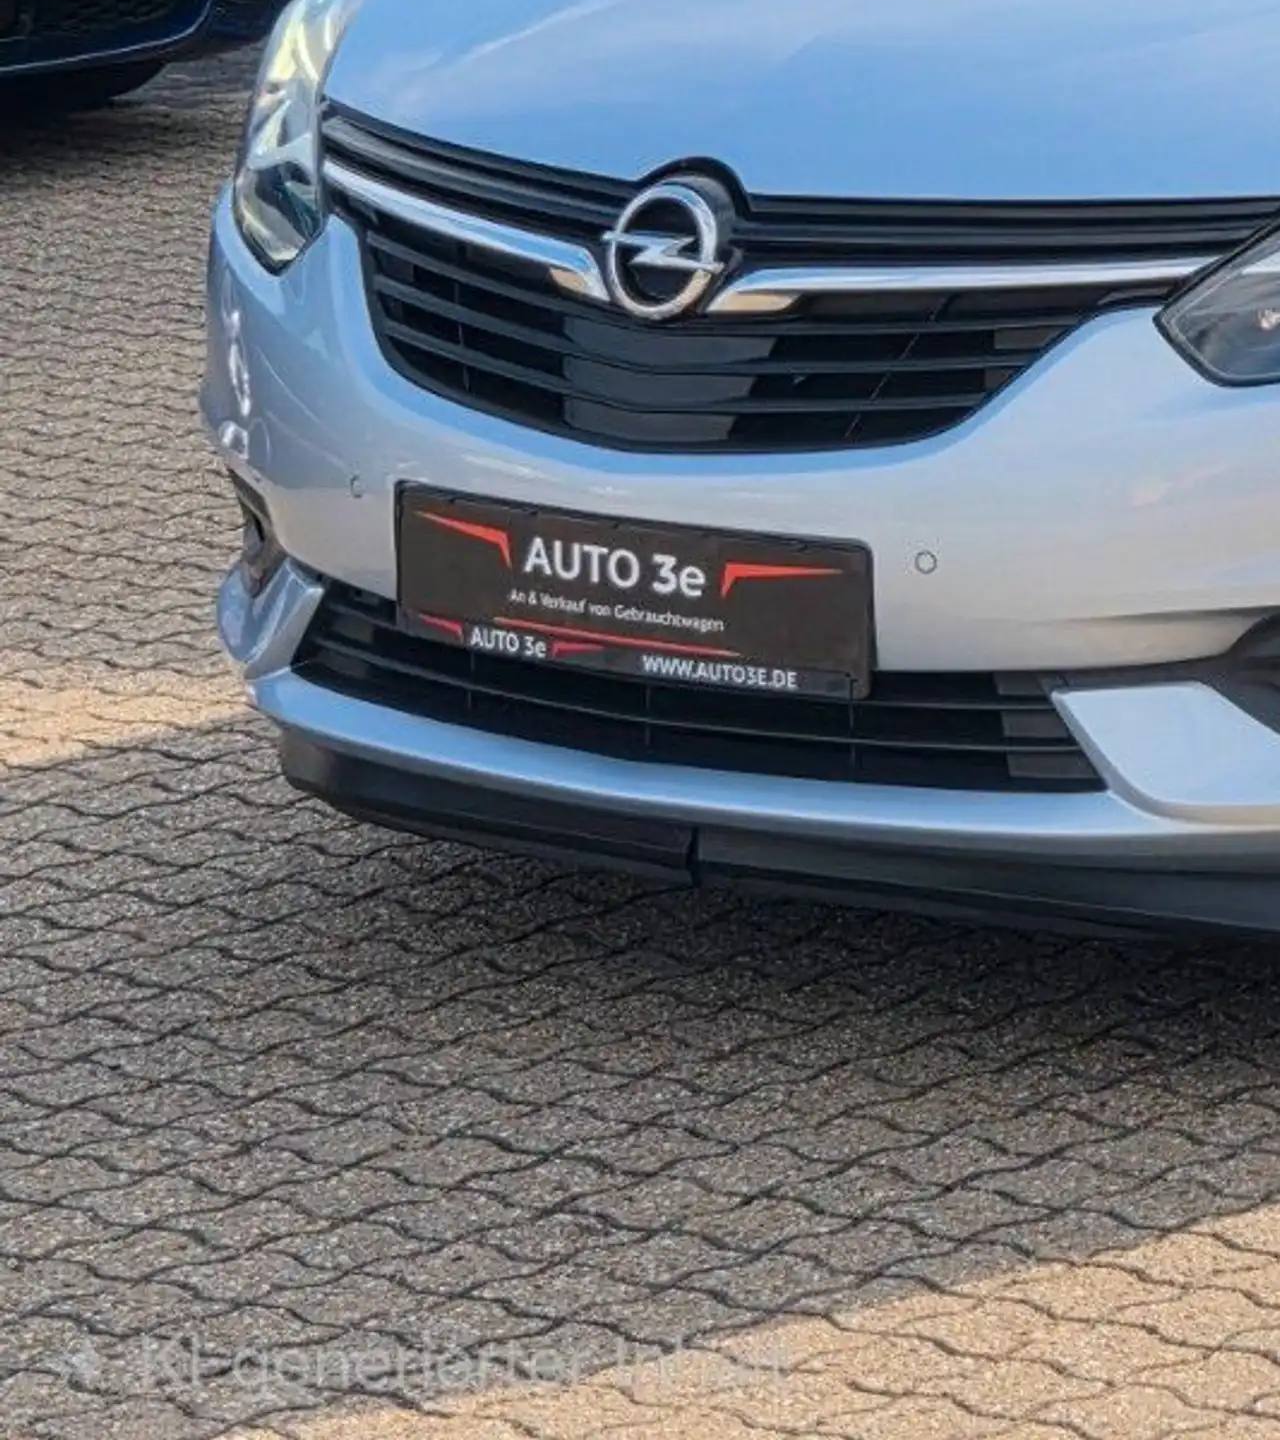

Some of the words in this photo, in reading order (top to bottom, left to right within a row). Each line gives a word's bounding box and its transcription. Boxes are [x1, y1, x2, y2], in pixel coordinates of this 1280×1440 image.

[524, 536, 639, 589] AUTO
[651, 553, 706, 598] 3e
[540, 593, 587, 614] Verkauf
[590, 604, 612, 617] von
[470, 626, 520, 653] AUTO
[525, 634, 547, 659] 3e
[641, 653, 799, 691] WWW.AUTO3E.DE
